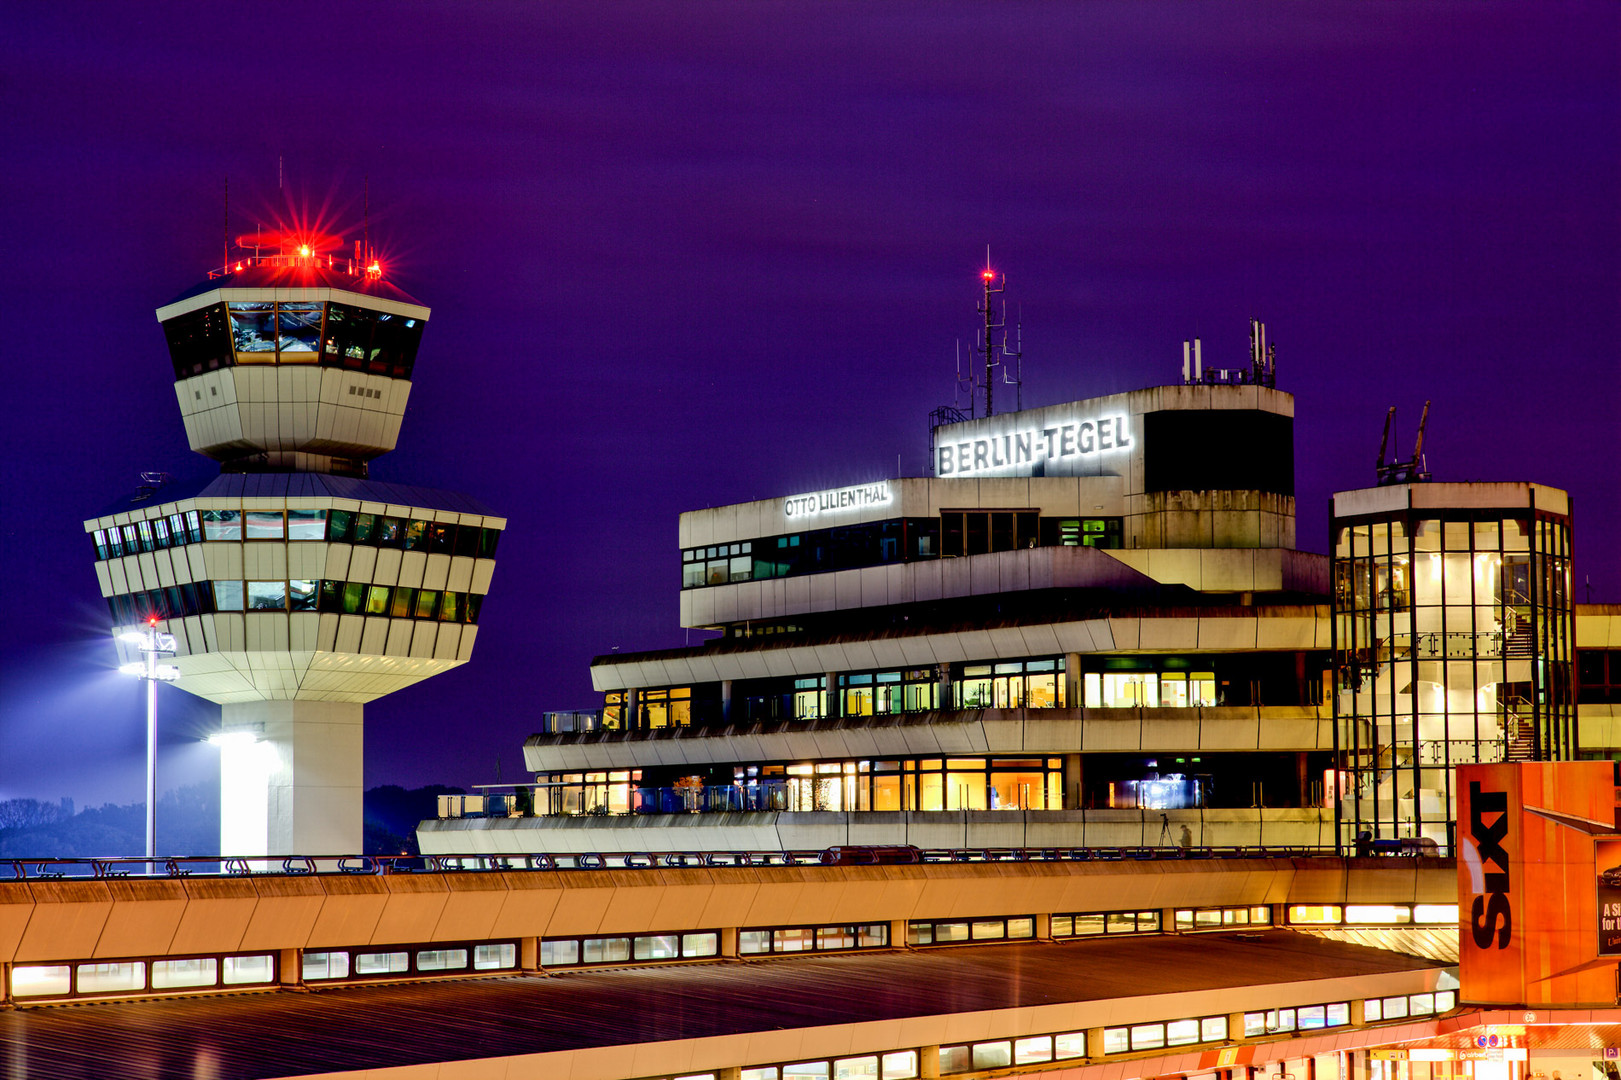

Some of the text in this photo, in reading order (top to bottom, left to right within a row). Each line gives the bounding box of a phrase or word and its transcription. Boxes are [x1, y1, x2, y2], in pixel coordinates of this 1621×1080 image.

[938, 416, 1130, 475] BERLIN-TEGEL
[784, 483, 889, 516] OTTO LILIENTHAL
[1469, 781, 1512, 950] SIXT
[1602, 918, 1615, 931] for
[1603, 904, 1610, 917] A
